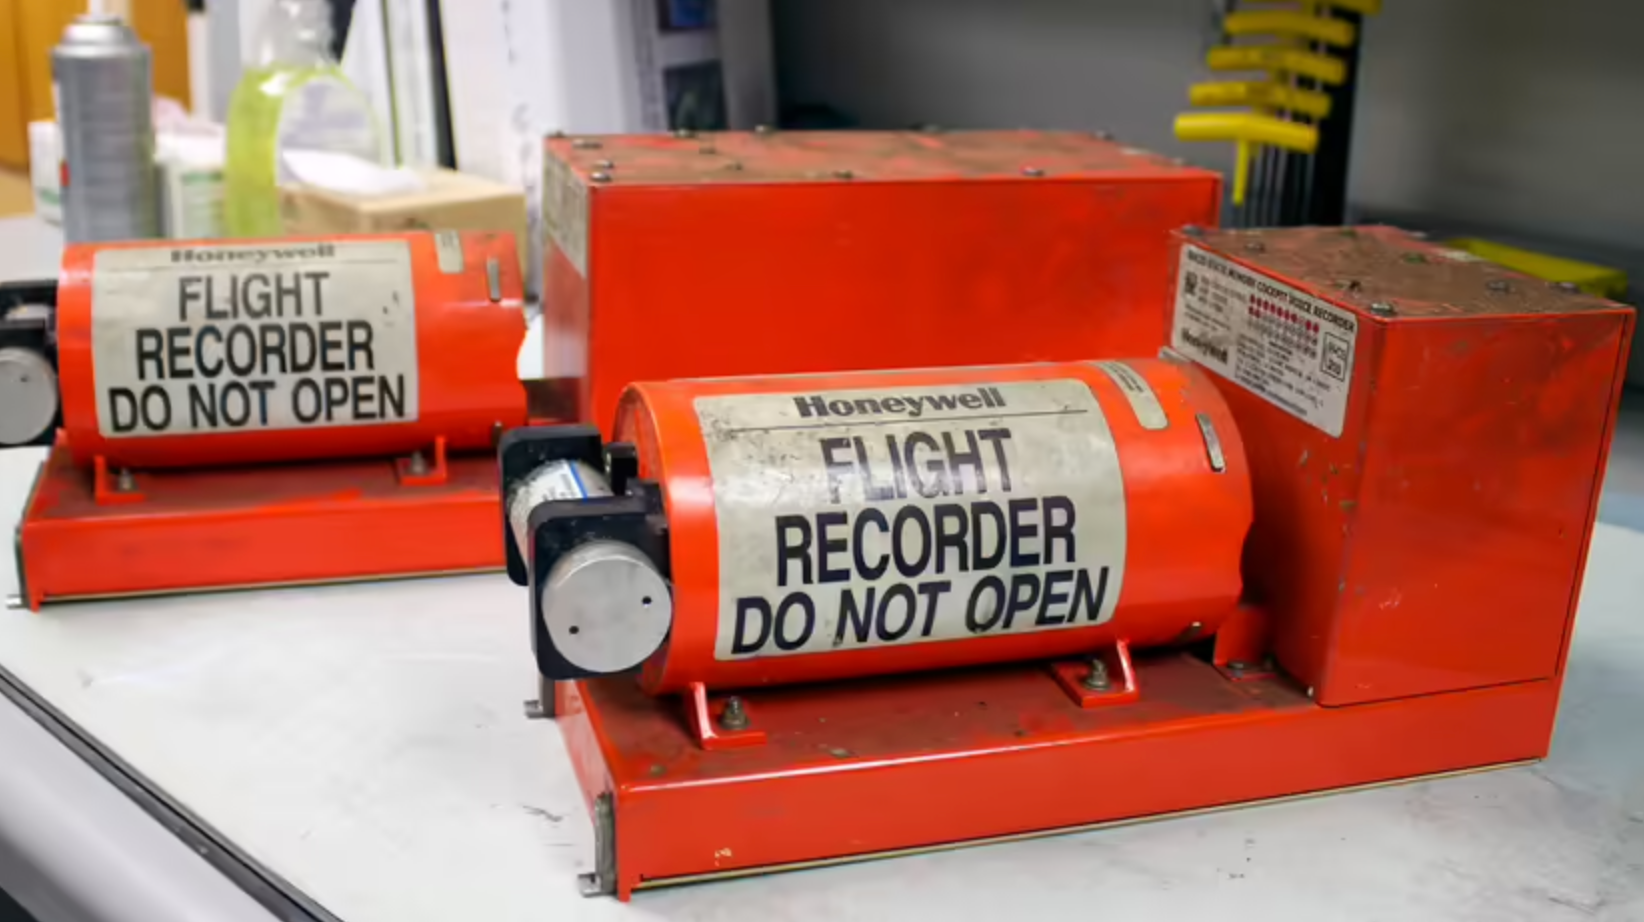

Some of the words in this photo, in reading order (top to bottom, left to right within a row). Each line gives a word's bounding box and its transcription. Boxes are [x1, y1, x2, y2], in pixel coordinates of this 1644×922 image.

[171, 243, 335, 264] Honeywell
[178, 271, 330, 322] FLIGHT
[136, 319, 375, 381] RECORDER
[108, 384, 172, 433] DO
[187, 380, 276, 429] NOT
[291, 374, 405, 424] OPEN
[793, 387, 1007, 418] Honeywell
[819, 427, 1013, 504] FLIGHT
[775, 495, 1077, 587] RECORDER
[731, 591, 816, 655] DO
[832, 580, 951, 647] NOT
[964, 566, 1110, 634] OPEN
